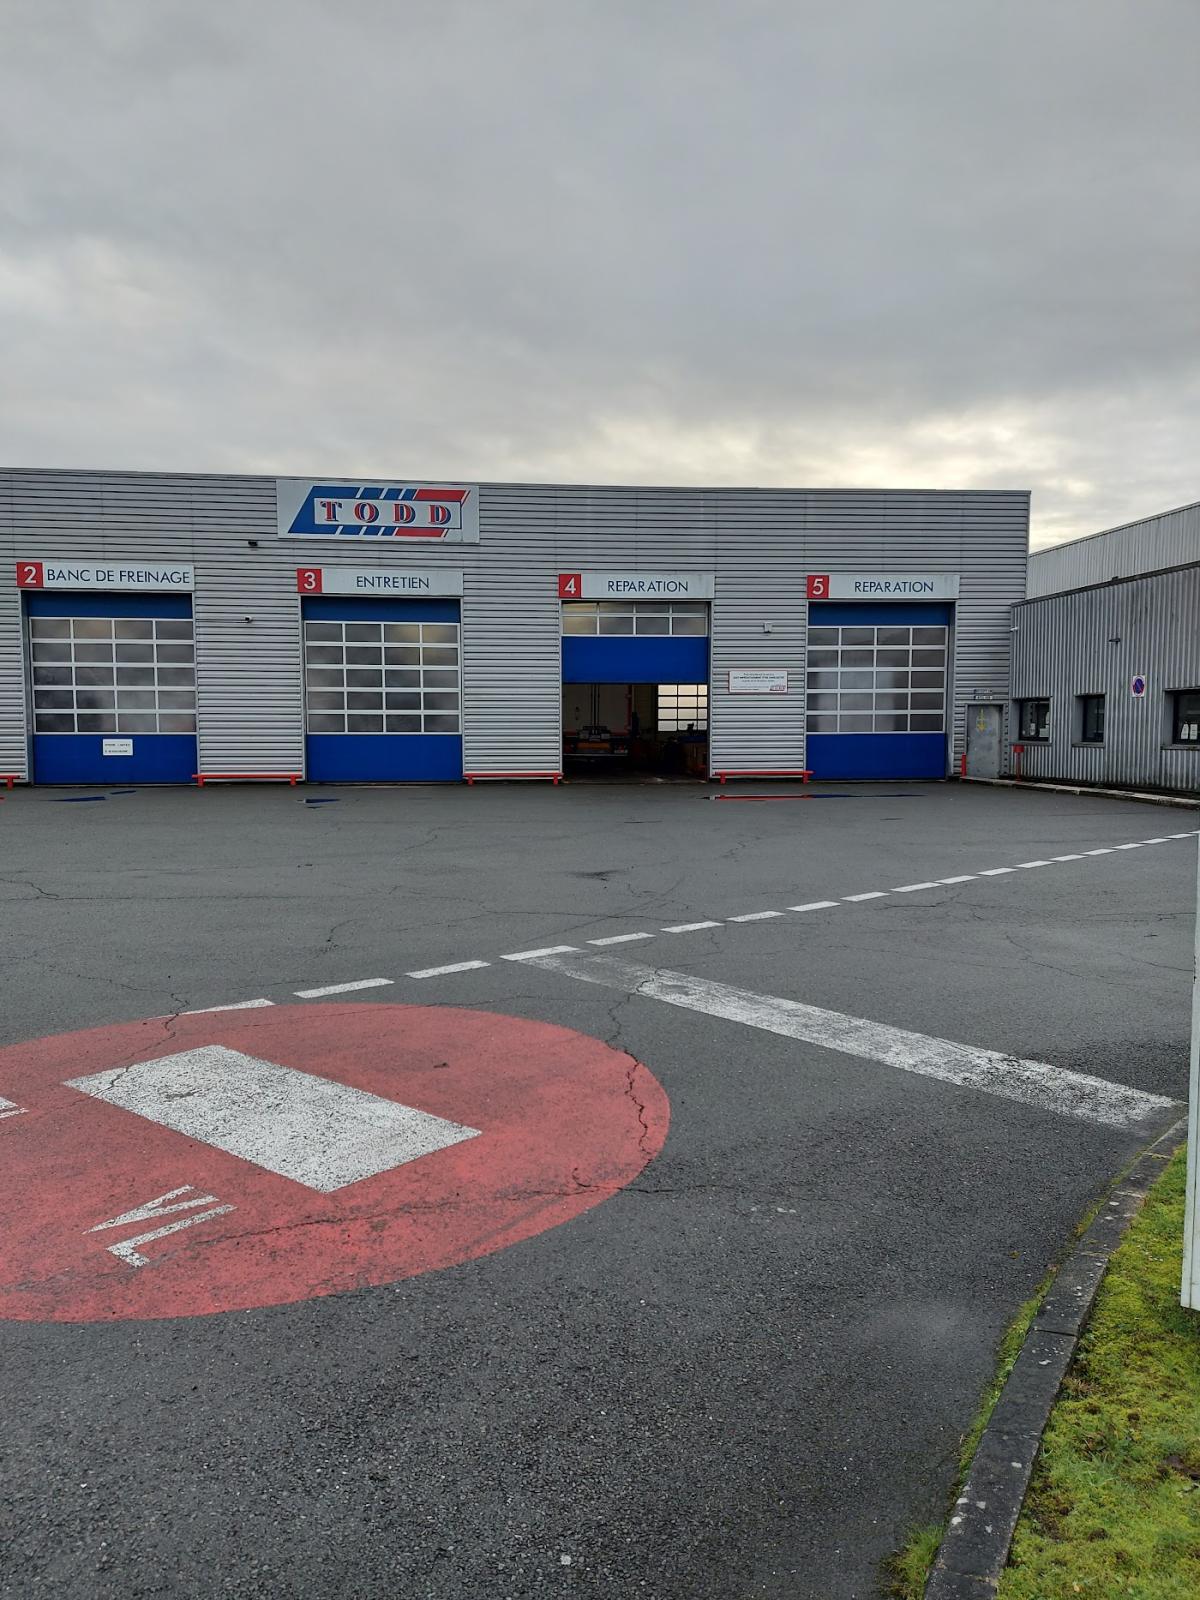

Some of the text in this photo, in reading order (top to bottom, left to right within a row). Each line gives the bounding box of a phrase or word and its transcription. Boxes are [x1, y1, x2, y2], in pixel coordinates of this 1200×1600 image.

[319, 501, 452, 525] TODD
[24, 566, 190, 584] 2 BANC DE FREINAGE
[304, 571, 430, 590] 3 ENTRETIEN
[564, 577, 689, 594] 4 REPARATION
[812, 578, 934, 595] 5 REPARATION
